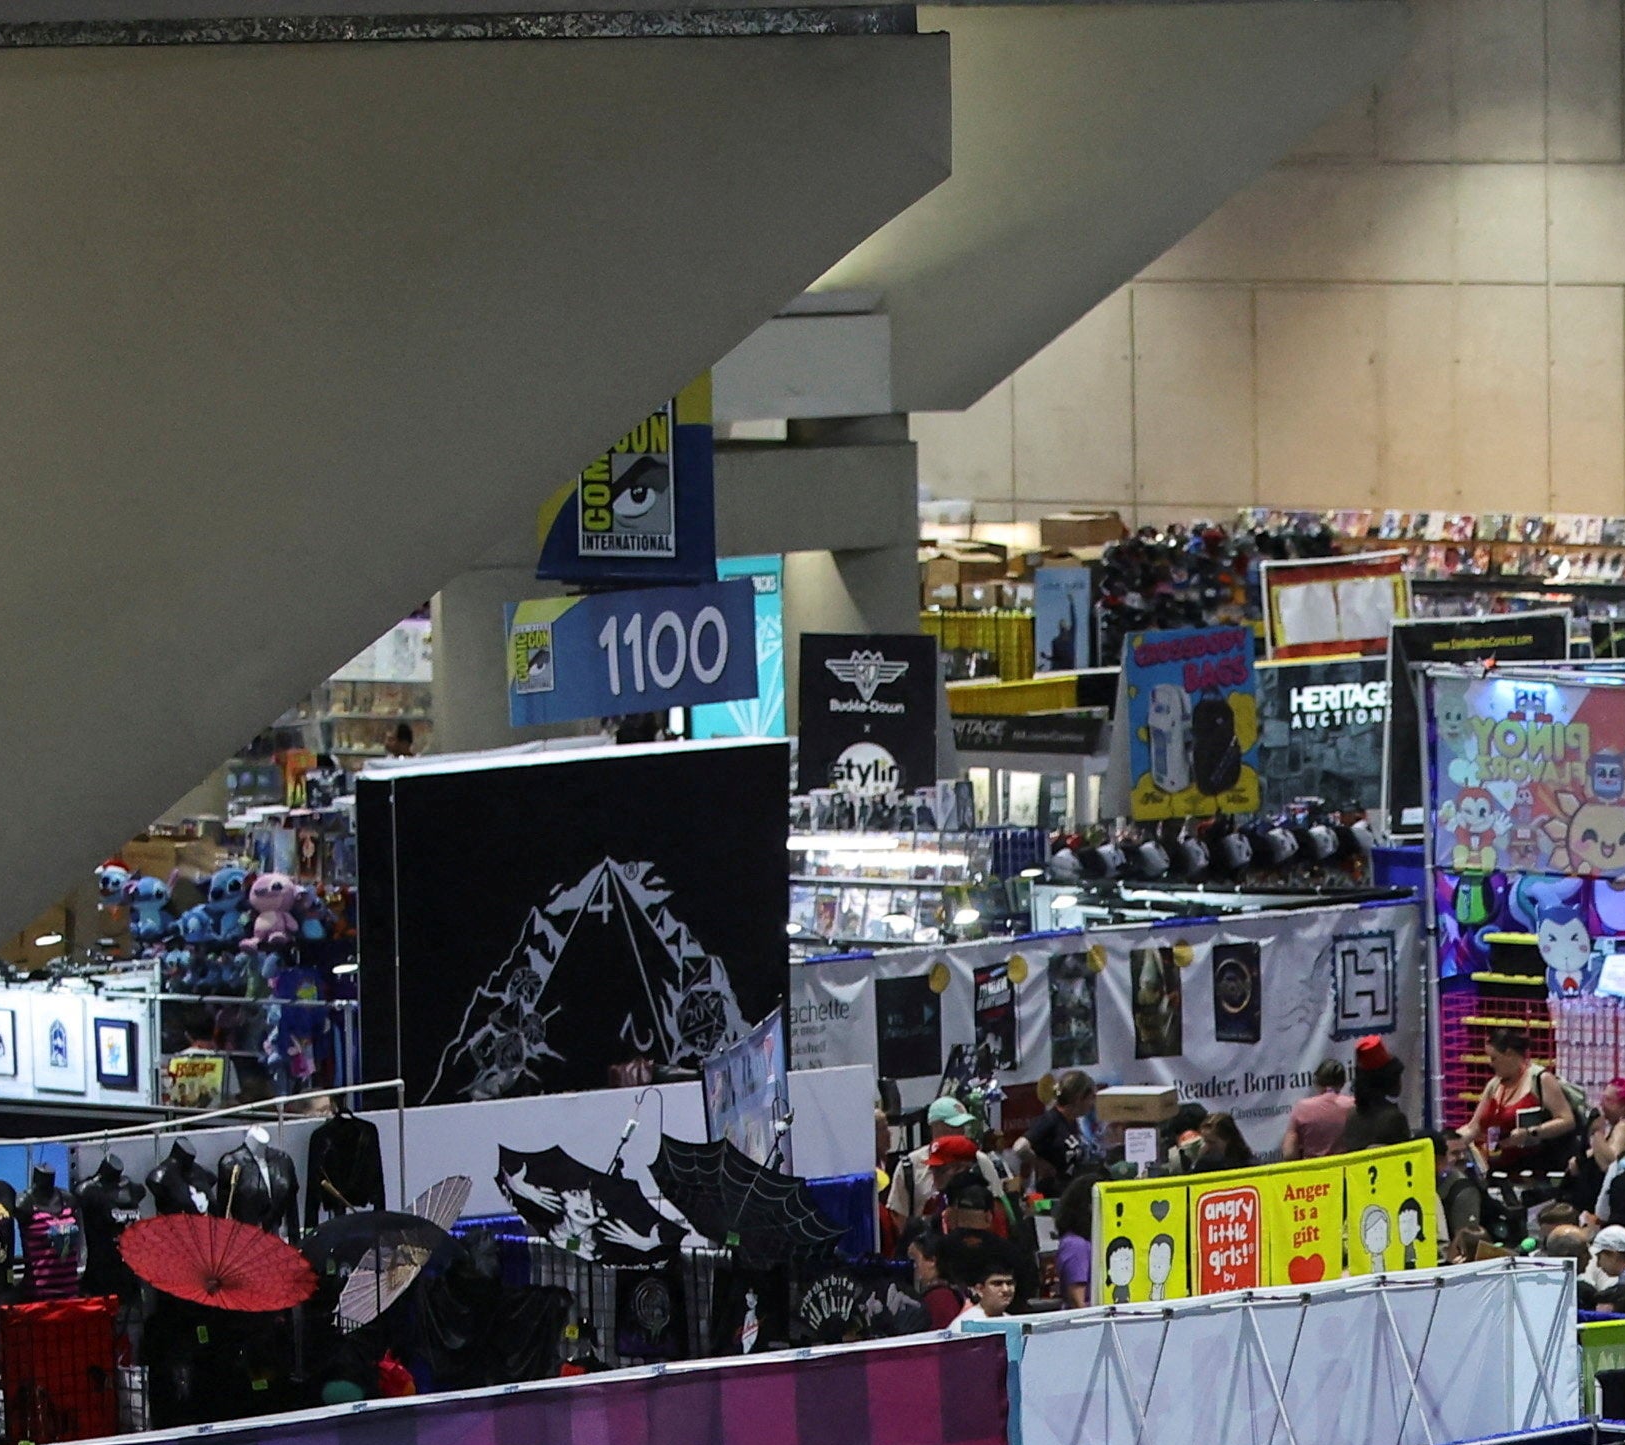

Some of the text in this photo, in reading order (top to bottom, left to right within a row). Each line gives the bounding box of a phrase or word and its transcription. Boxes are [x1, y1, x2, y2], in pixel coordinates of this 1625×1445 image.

[581, 534, 672, 553] INTERNATIONAL
[598, 605, 729, 696] 1100
[1182, 657, 1248, 693] BAGS
[1290, 681, 1387, 713] HERITAGE
[1244, 1070, 1286, 1097] Born
[1230, 1102, 1293, 1122] Convention
[1283, 1181, 1331, 1203] Anger
[1204, 1195, 1255, 1222] angry
[1293, 1205, 1320, 1223] is a
[1208, 1222, 1249, 1245] little
[1292, 1226, 1320, 1250] gift
[1208, 1242, 1250, 1276] girls!
[1223, 1270, 1236, 1284] by
